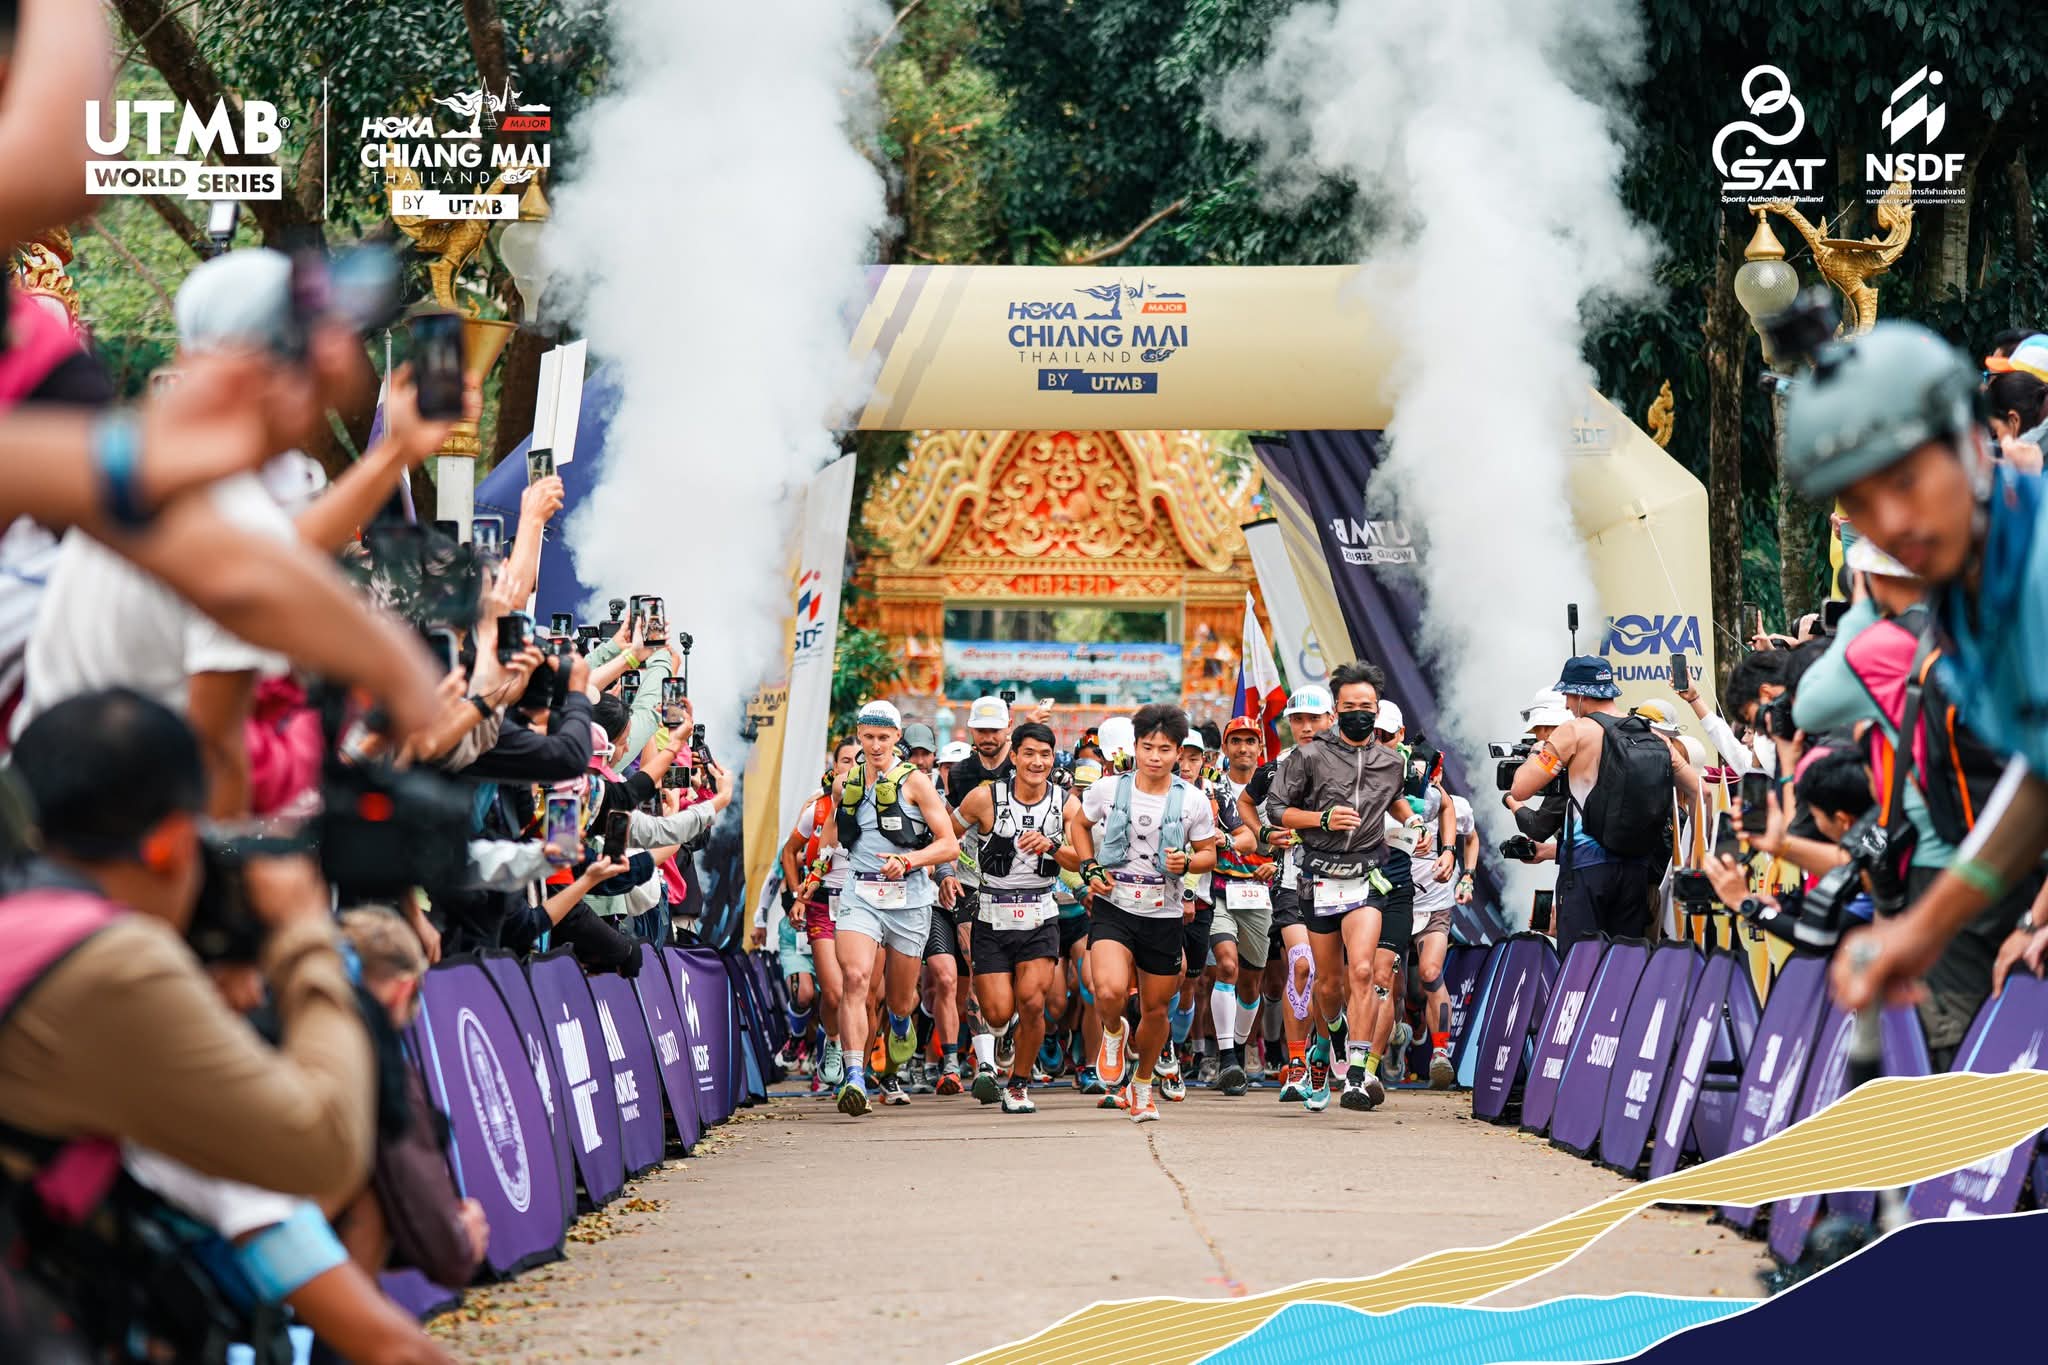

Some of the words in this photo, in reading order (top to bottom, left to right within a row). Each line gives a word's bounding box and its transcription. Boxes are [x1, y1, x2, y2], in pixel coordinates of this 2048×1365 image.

[1008, 302, 1077, 320] HOKA
[1148, 303, 1183, 312] MAJOR
[1008, 325, 1123, 348] CHIANG
[1132, 325, 1188, 347] MAI
[1018, 351, 1131, 363] THAILAND
[1047, 373, 1069, 387] BY
[1091, 376, 1143, 391] UTMB
[1310, 858, 1362, 876] FUGA
[877, 888, 885, 897] 6
[1135, 890, 1141, 898] 8
[1012, 909, 1025, 918] 10
[1586, 1033, 1619, 1069] SUUNTO
